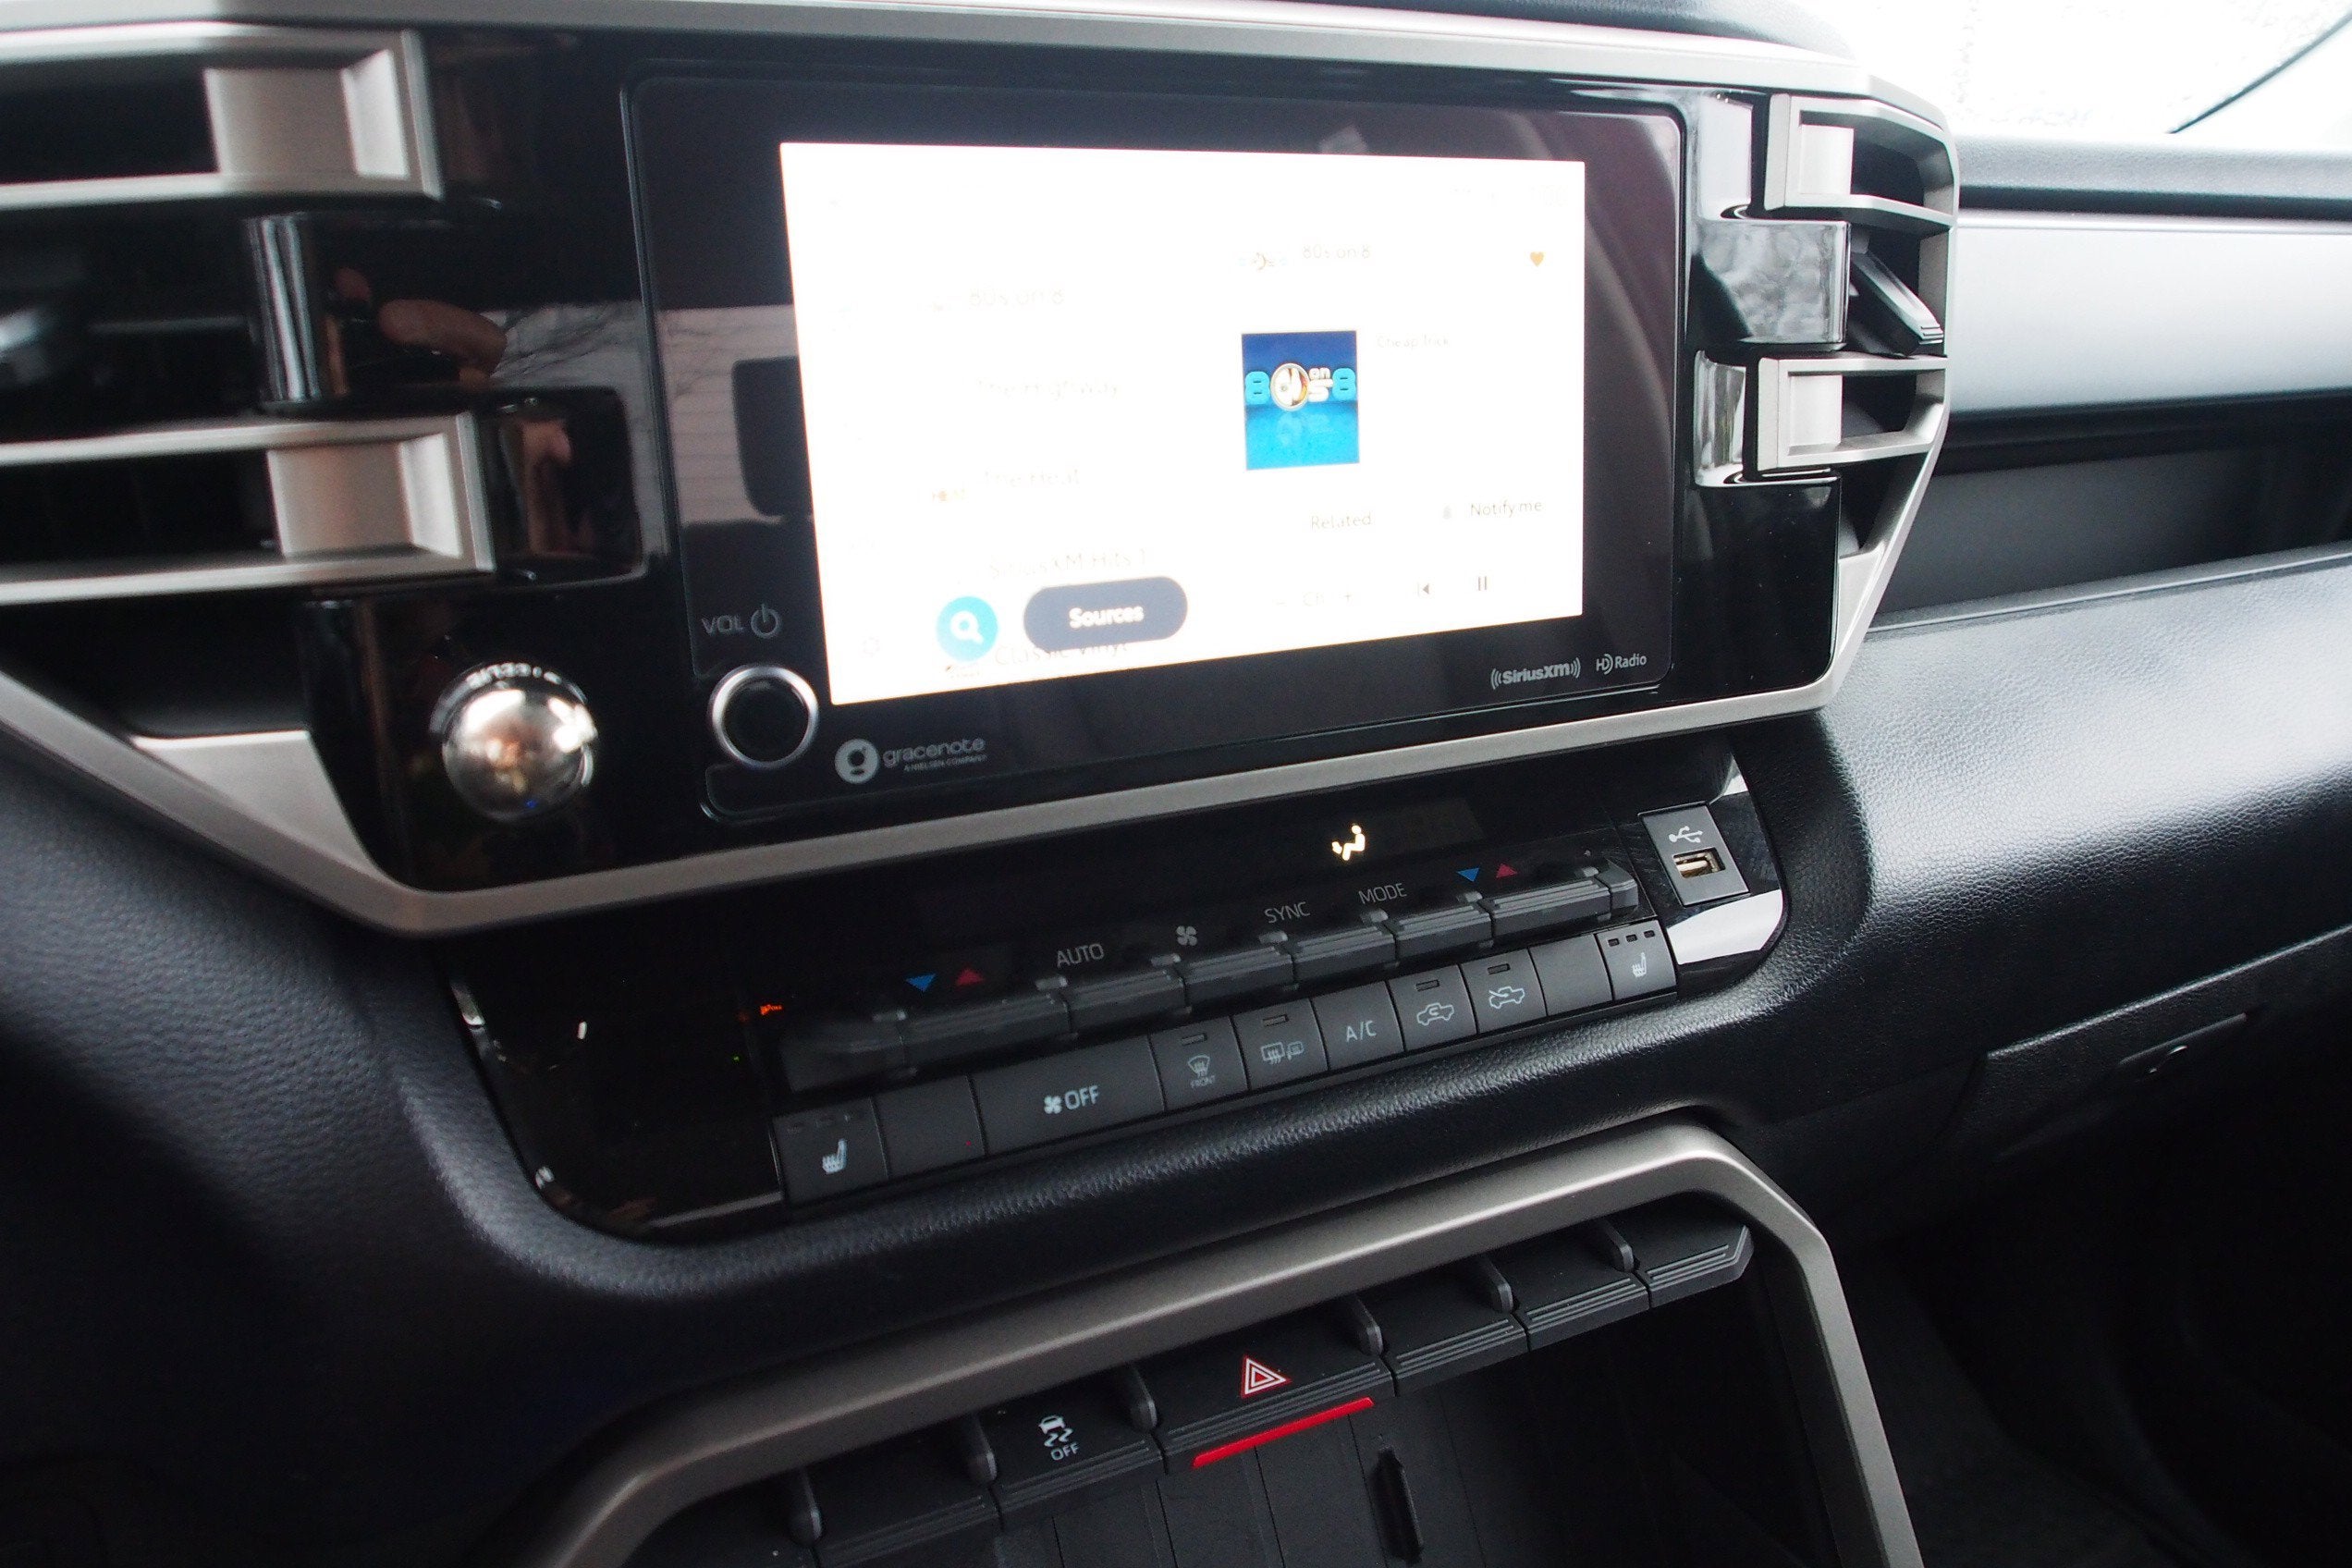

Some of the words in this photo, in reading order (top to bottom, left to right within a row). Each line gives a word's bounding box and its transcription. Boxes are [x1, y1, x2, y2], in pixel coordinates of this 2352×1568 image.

[1470, 499, 1515, 519] Notify
[1519, 500, 1543, 513] me
[1310, 513, 1373, 531] Related
[702, 614, 743, 636] VOL
[1069, 606, 1145, 629] Sources
[1615, 654, 1648, 668] Radio
[883, 737, 986, 768] gracenote
[1358, 882, 1407, 905] MODE
[1264, 901, 1311, 924] SYNC
[1056, 943, 1104, 967] AUTO
[1345, 1019, 1377, 1042] A/C
[1064, 1084, 1100, 1110] OFF
[1050, 1441, 1079, 1461] OFF
